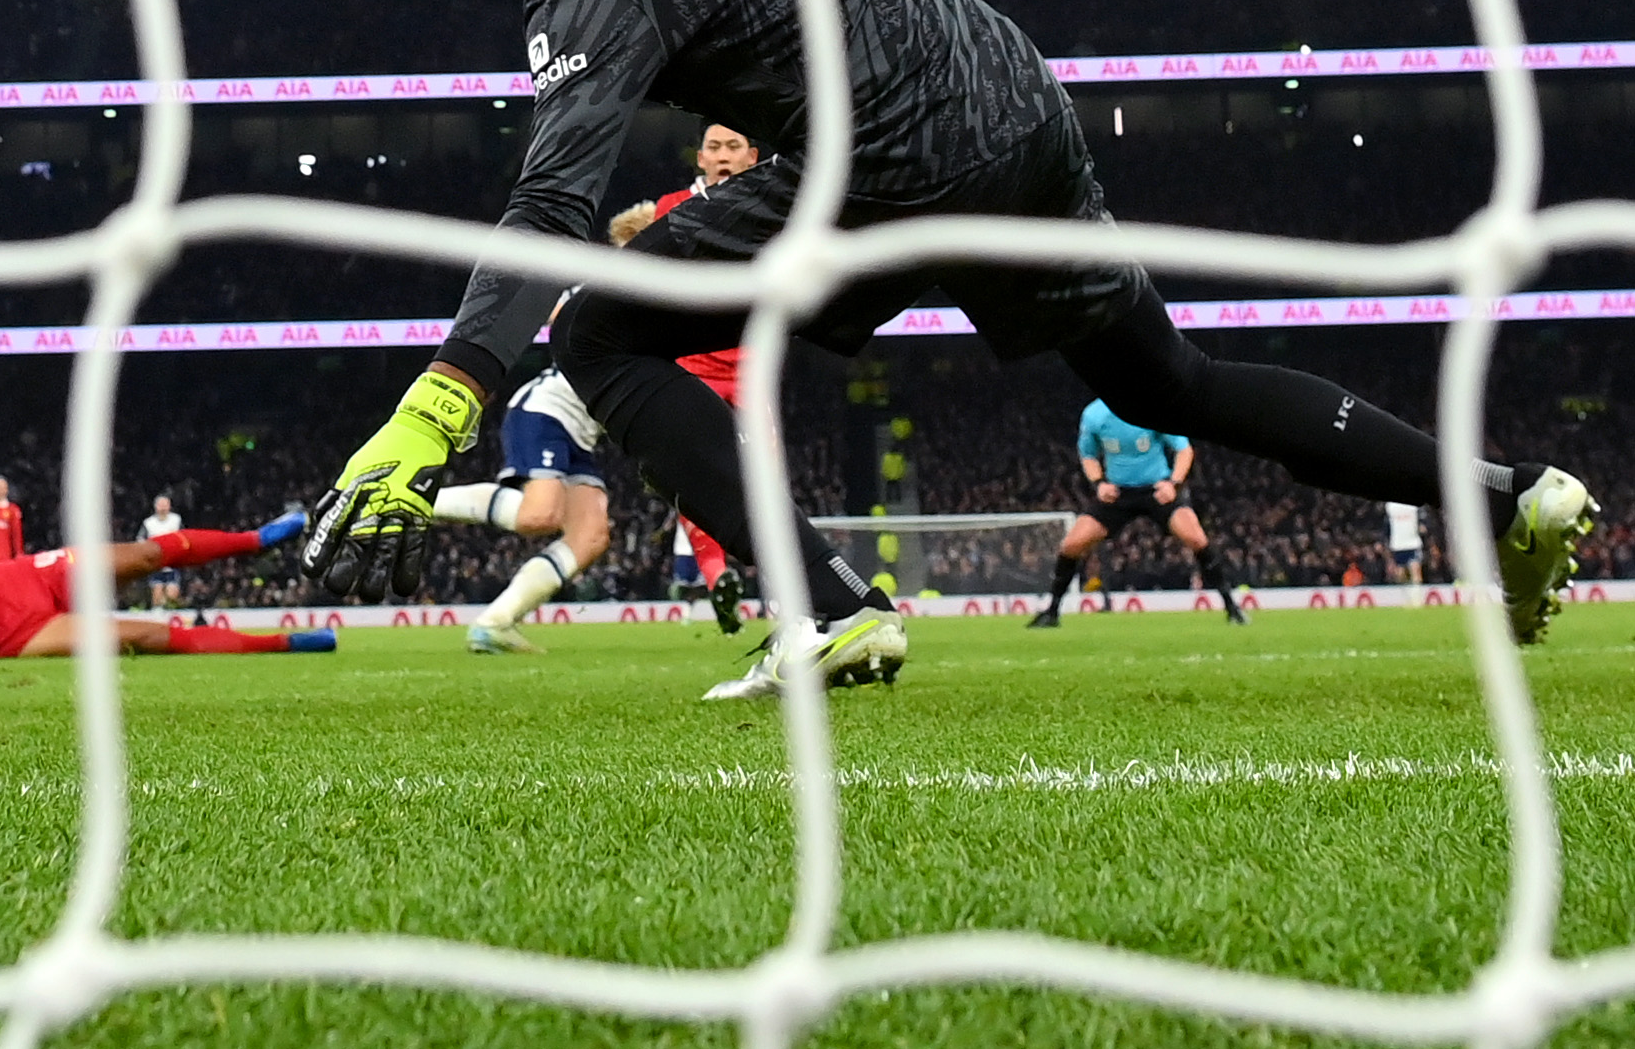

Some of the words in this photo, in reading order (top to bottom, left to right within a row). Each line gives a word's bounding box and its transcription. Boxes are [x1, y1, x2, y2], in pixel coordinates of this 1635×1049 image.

[1341, 53, 1378, 68] AIA
[1401, 51, 1438, 67] AIA
[1522, 47, 1558, 63] AIA
[1581, 45, 1617, 60] AIA
[1102, 60, 1139, 75] AIA
[1162, 58, 1198, 73] AIA
[1222, 57, 1259, 72] AIA
[1282, 55, 1318, 70] AIA
[217, 82, 253, 99] AIA
[275, 81, 312, 98] AIA
[334, 80, 370, 96] AIA
[392, 78, 429, 95] AIA
[451, 77, 487, 93] AIA
[510, 76, 533, 90] AI
[43, 85, 79, 100] AIA
[100, 83, 137, 100] AIA
[1219, 304, 1259, 322] AIA
[1284, 303, 1323, 320] AIA
[1346, 301, 1386, 318] AIA
[1410, 300, 1449, 317] AIA
[1536, 297, 1575, 313] AIA
[904, 313, 942, 328] AIA
[36, 330, 74, 346] AIA
[158, 329, 196, 344] AIA
[220, 328, 257, 343] AIA
[282, 327, 319, 342] AIA
[343, 325, 381, 341] AIA
[405, 324, 443, 340] AIA
[1332, 395, 1356, 432] LFC
[1310, 591, 1375, 609] AIA
[394, 609, 458, 626] AIA
[621, 606, 682, 623] AIA
